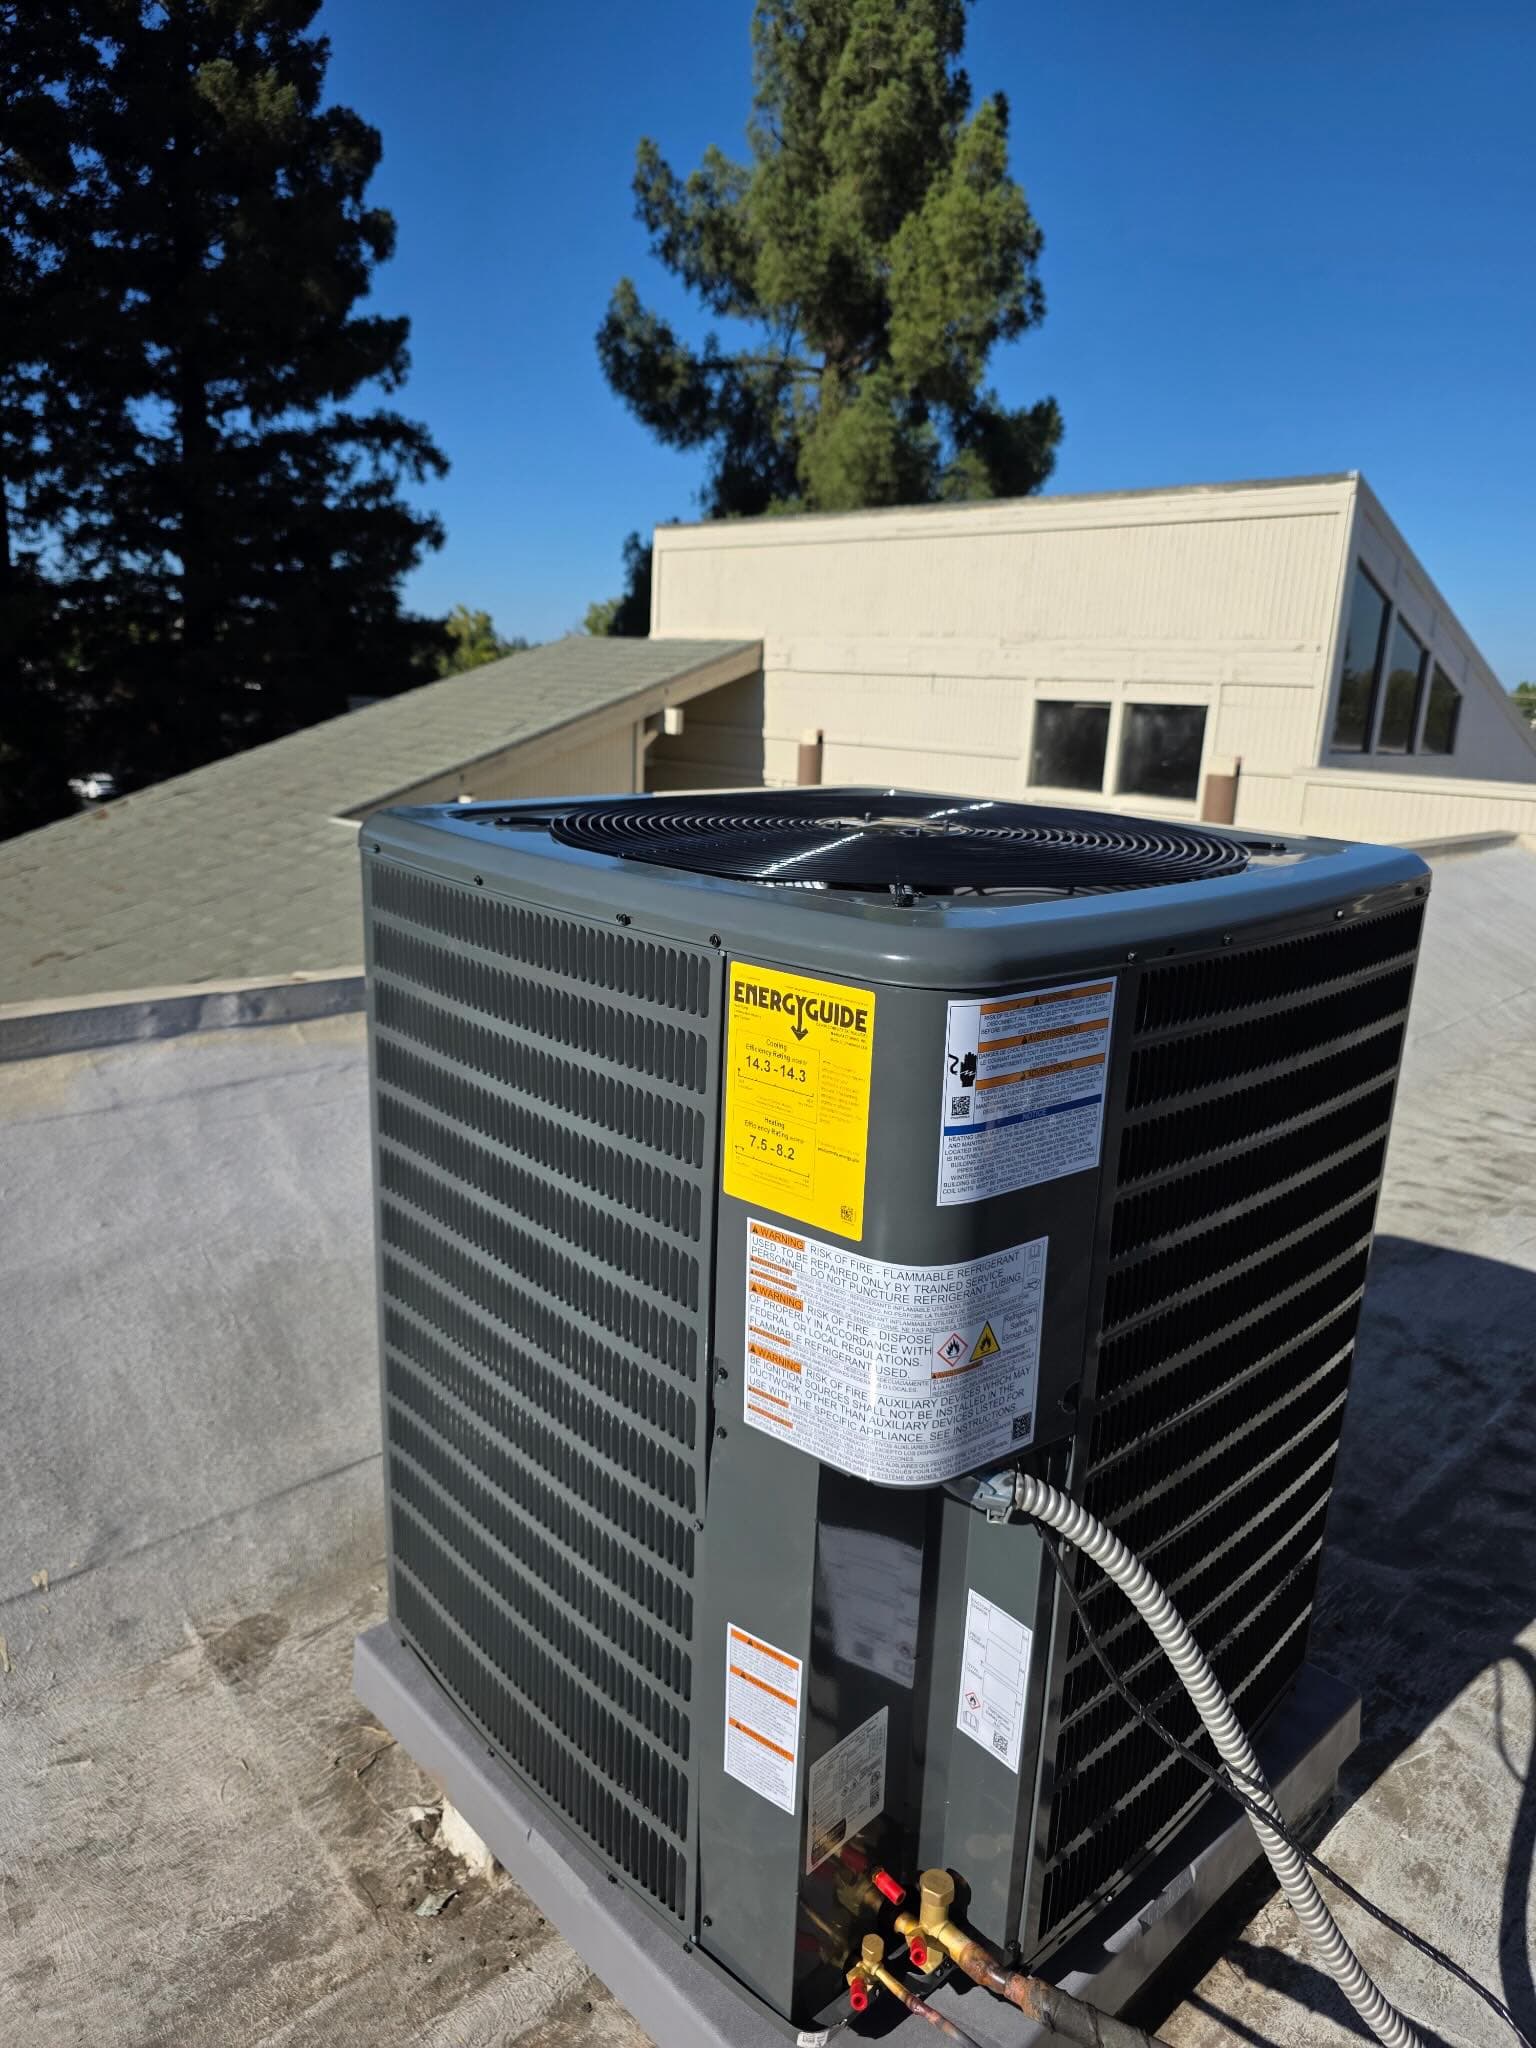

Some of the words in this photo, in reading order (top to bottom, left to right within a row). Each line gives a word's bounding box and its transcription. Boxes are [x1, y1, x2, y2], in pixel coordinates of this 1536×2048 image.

[734, 981, 868, 1033] ENERGYGUIDE
[745, 1043, 772, 1056] Efficiency
[773, 1050, 790, 1063] Rating
[766, 1038, 787, 1051] Cooling
[744, 1119, 771, 1134] Efficiency
[771, 1128, 789, 1141] Rating
[764, 1117, 785, 1130] Heating
[760, 1229, 804, 1251] WARNING
[810, 1245, 831, 1261] RISK
[834, 1253, 848, 1264] OF
[850, 1259, 873, 1274] FIRE
[883, 1268, 954, 1282] FLAMMABLE
[957, 1252, 1020, 1278] REFRIGERANT
[781, 1246, 794, 1259] TO
[796, 1251, 808, 1264] BE
[810, 1257, 859, 1281] REPAIRED
[861, 1275, 891, 1290] ONLY
[894, 1282, 910, 1293] BY
[914, 1281, 963, 1294] TRAINED
[965, 1269, 1004, 1288] SERVICE
[810, 1268, 825, 1280] DO
[826, 1274, 847, 1289] NOT
[849, 1280, 910, 1304] PUNCTURE
[913, 1283, 988, 1305] REFRIGERANT
[749, 1294, 761, 1304] OF
[763, 1300, 811, 1323] PROPERLY
[814, 1319, 823, 1330] IN
[825, 1324, 898, 1354] ACCORDANCE
[902, 1346, 932, 1356] WITH
[750, 1304, 790, 1327] FEDERAL
[793, 1321, 807, 1333] OR
[809, 1327, 839, 1347] LOCAL
[759, 1288, 803, 1310] WARNING
[807, 1305, 829, 1319] RISK
[831, 1314, 845, 1326] OF
[847, 1321, 869, 1336] FIRE
[880, 1331, 932, 1345] DISPOSE
[750, 1318, 802, 1342] FLAMMABLE
[804, 1340, 871, 1371] REFRIGERANT
[750, 1355, 761, 1365] BE
[763, 1361, 803, 1385] IGNITION
[804, 1380, 850, 1405] SOURCES
[852, 1399, 886, 1417] SHALL
[889, 1409, 915, 1420] NOT
[917, 1410, 933, 1420] BE
[935, 1393, 986, 1418] INSTALLED
[988, 1391, 998, 1400] IN
[1000, 1383, 1015, 1395] THE
[759, 1348, 802, 1374] WARNING
[806, 1369, 828, 1383] RISK
[830, 1379, 844, 1391] OF
[845, 1385, 868, 1400] FIRE
[877, 1397, 938, 1409] AUXILIARY
[941, 1388, 979, 1407] DEVICES
[982, 1376, 1010, 1393] WHICH
[1012, 1367, 1032, 1381] MAY
[750, 1375, 767, 1389] USE
[768, 1386, 792, 1401] WITH
[795, 1396, 812, 1410] THE
[814, 1405, 857, 1430] SPECIFIC
[930, 1429, 951, 1440] SEE
[805, 1389, 837, 1410] OTHER
[840, 1404, 866, 1423] THAN
[868, 1416, 929, 1431] AUXILIARY
[931, 1408, 974, 1429] DEVICES
[976, 1397, 1005, 1417] LISTED
[1007, 1388, 1025, 1402] FOR
